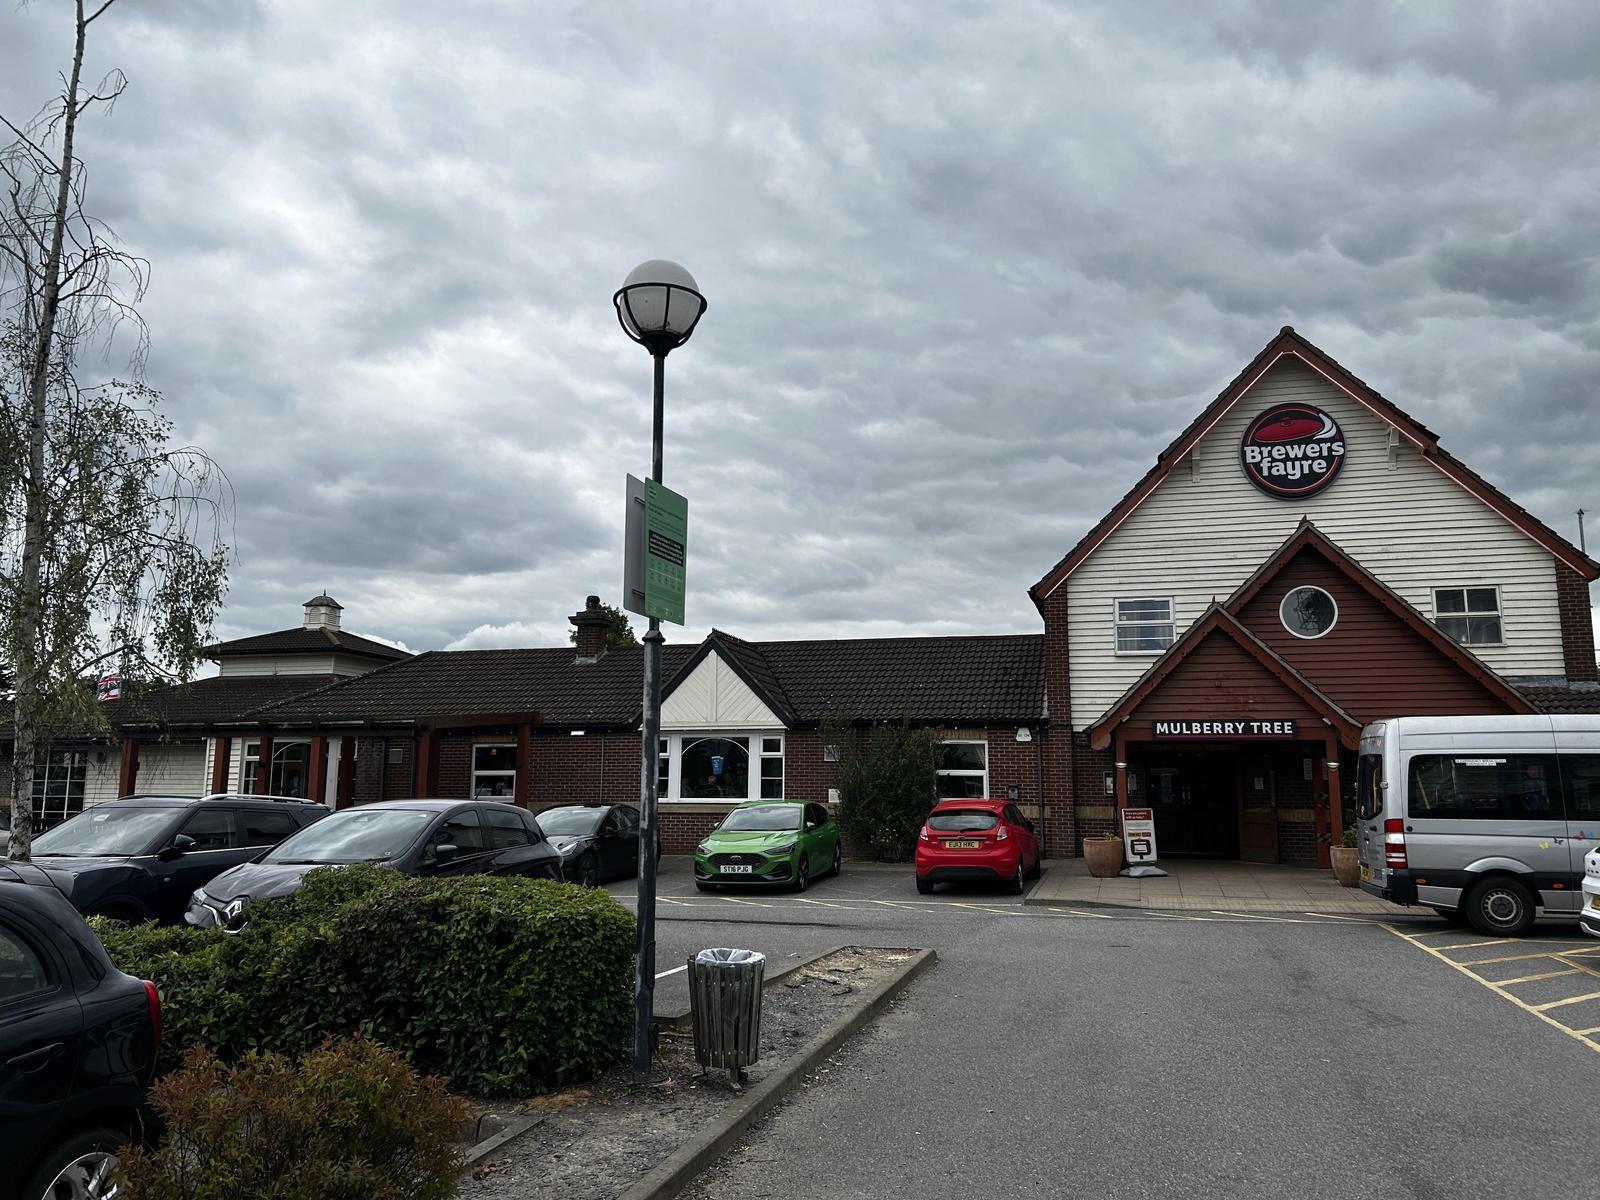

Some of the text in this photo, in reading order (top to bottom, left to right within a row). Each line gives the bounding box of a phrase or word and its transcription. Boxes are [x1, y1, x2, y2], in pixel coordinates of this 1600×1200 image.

[1244, 441, 1345, 463] Brewers
[1260, 457, 1327, 480] fayre
[1156, 722, 1293, 734] MULBERRY TREE
